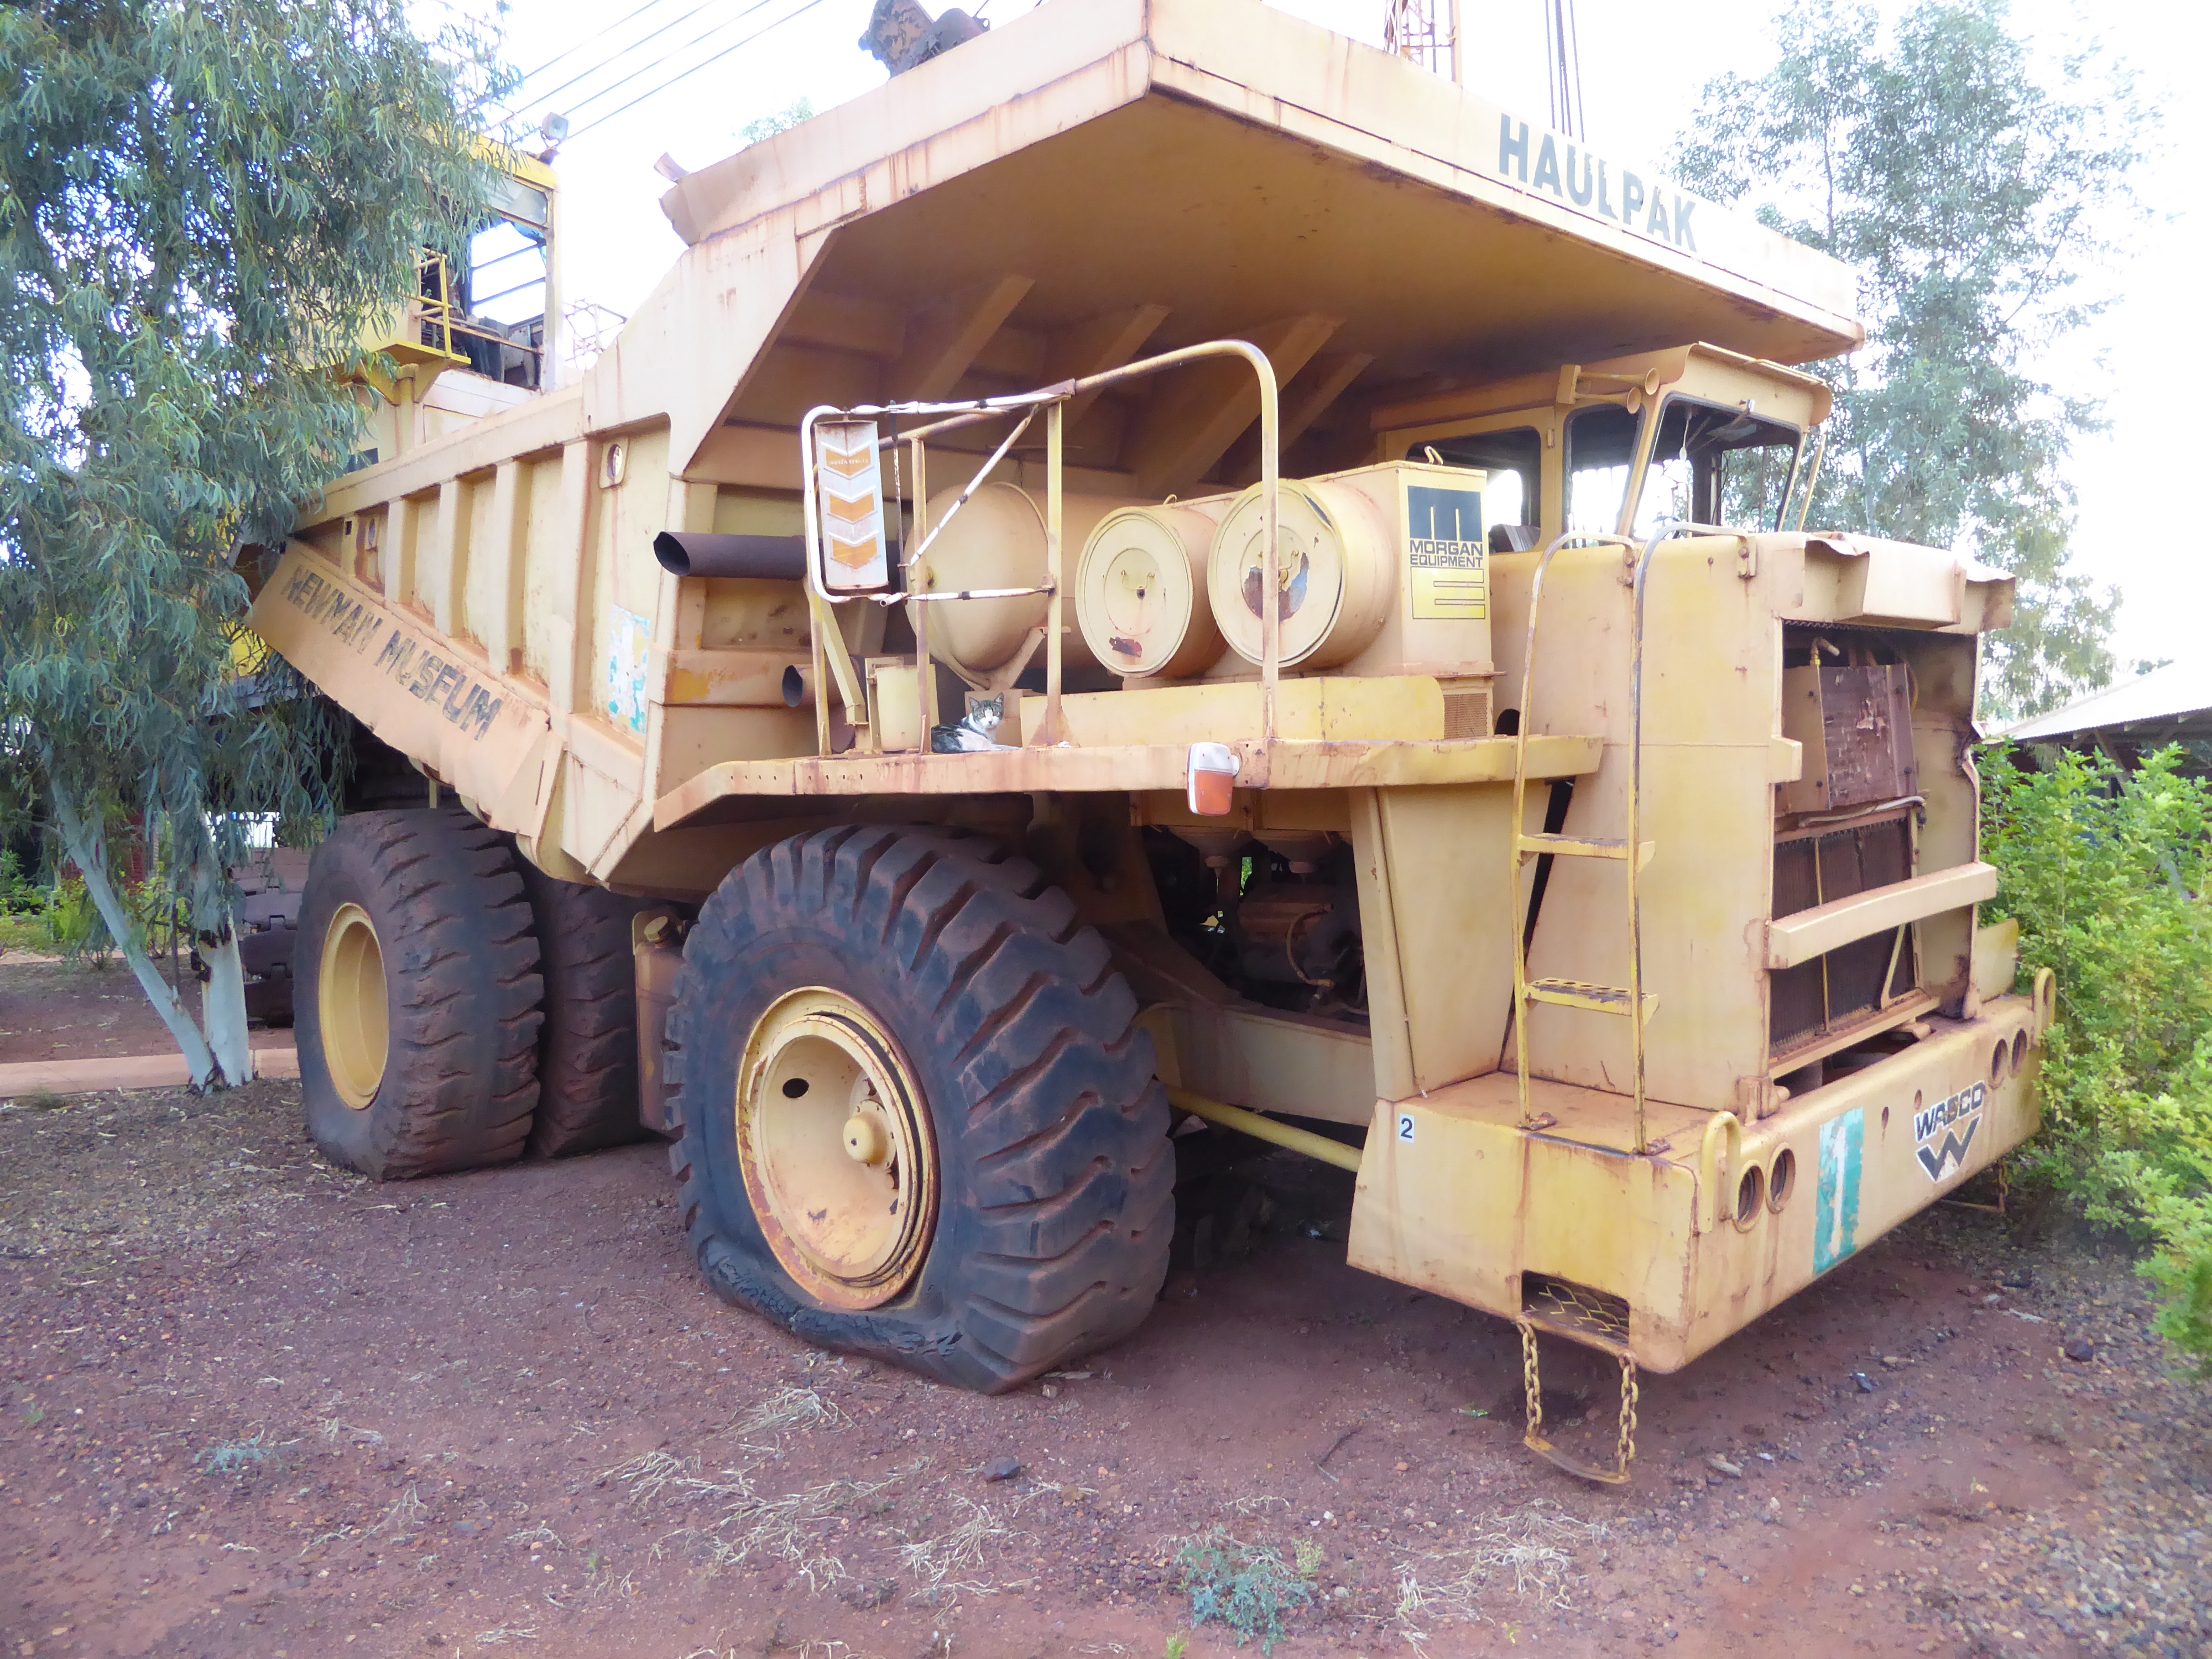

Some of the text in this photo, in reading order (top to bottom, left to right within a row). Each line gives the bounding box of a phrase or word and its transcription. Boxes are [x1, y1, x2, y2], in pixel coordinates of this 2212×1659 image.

[1499, 113, 1697, 253] HAULPAK
[1410, 540, 1483, 556] MORGAN
[1411, 555, 1483, 567] EQUIPMENT
[280, 565, 503, 742] NEWMAN MUSEUM
[1400, 1117, 1413, 1139] 2
